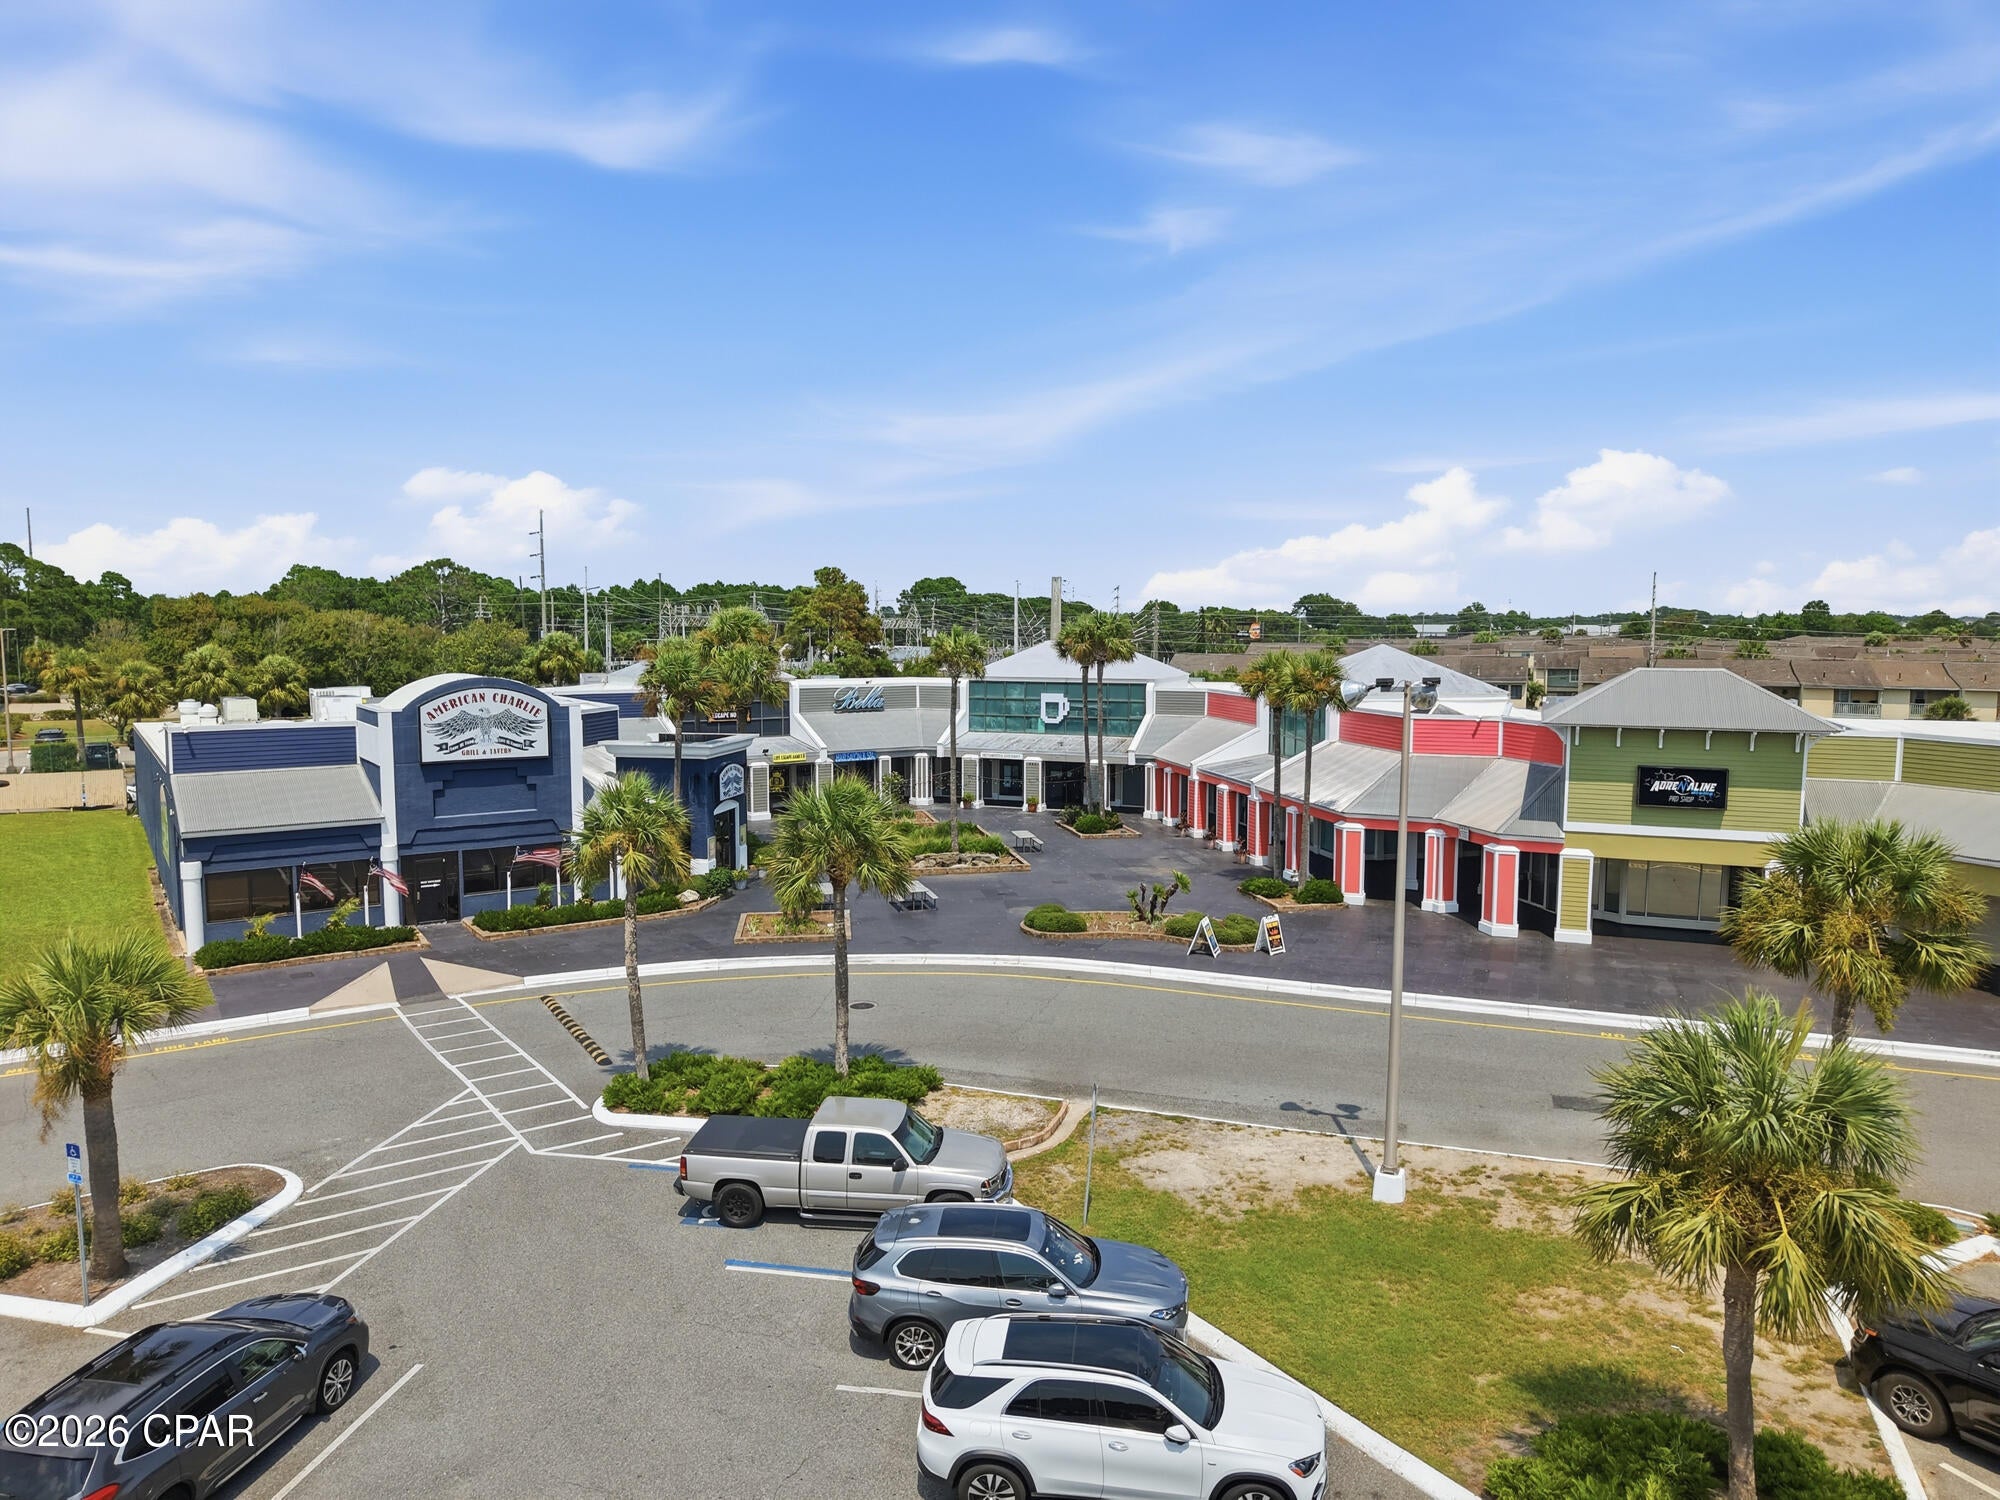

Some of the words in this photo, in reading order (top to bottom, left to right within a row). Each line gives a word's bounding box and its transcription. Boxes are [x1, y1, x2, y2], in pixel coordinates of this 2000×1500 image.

[426, 692, 486, 721] AMERICAN
[493, 692, 542, 718] CHARLIE
[832, 686, 886, 711] Bella
[461, 748, 479, 756] GRILL
[490, 748, 512, 756] TAVERN
[1650, 780, 1717, 793] ADRENALINE
